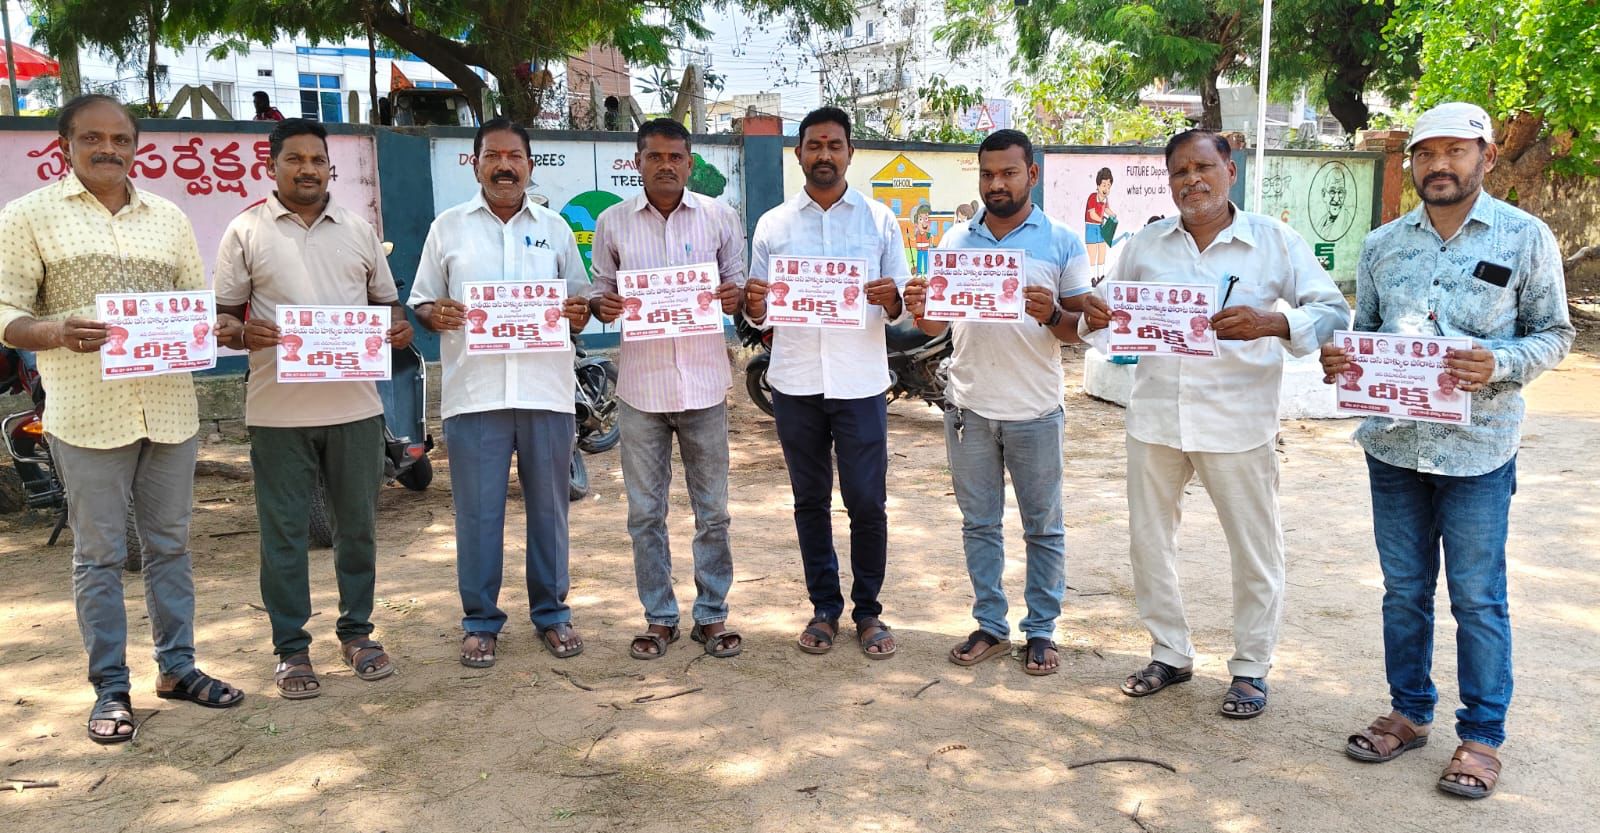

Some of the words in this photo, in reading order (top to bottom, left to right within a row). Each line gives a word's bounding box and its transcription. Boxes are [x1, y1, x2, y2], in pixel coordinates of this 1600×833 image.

[531, 154, 566, 167] REES
[612, 159, 639, 170] SAV
[611, 175, 645, 187] TREE
[1126, 165, 1150, 177] FUTURE
[1150, 165, 1169, 181] Depen
[893, 179, 912, 188] SCHOOL
[1126, 184, 1142, 195] what
[1144, 187, 1157, 197] you
[1158, 184, 1167, 194] do
[792, 298, 838, 317] దీక్ష
[951, 292, 998, 311] దీక్ష
[647, 308, 696, 325] దీక్ష
[492, 323, 543, 341] దీక్ష
[1138, 325, 1188, 348] దీక్ష
[134, 341, 189, 360] దీక్ష
[307, 351, 361, 370] దీక్ష
[1368, 382, 1432, 409] దీక్ష
